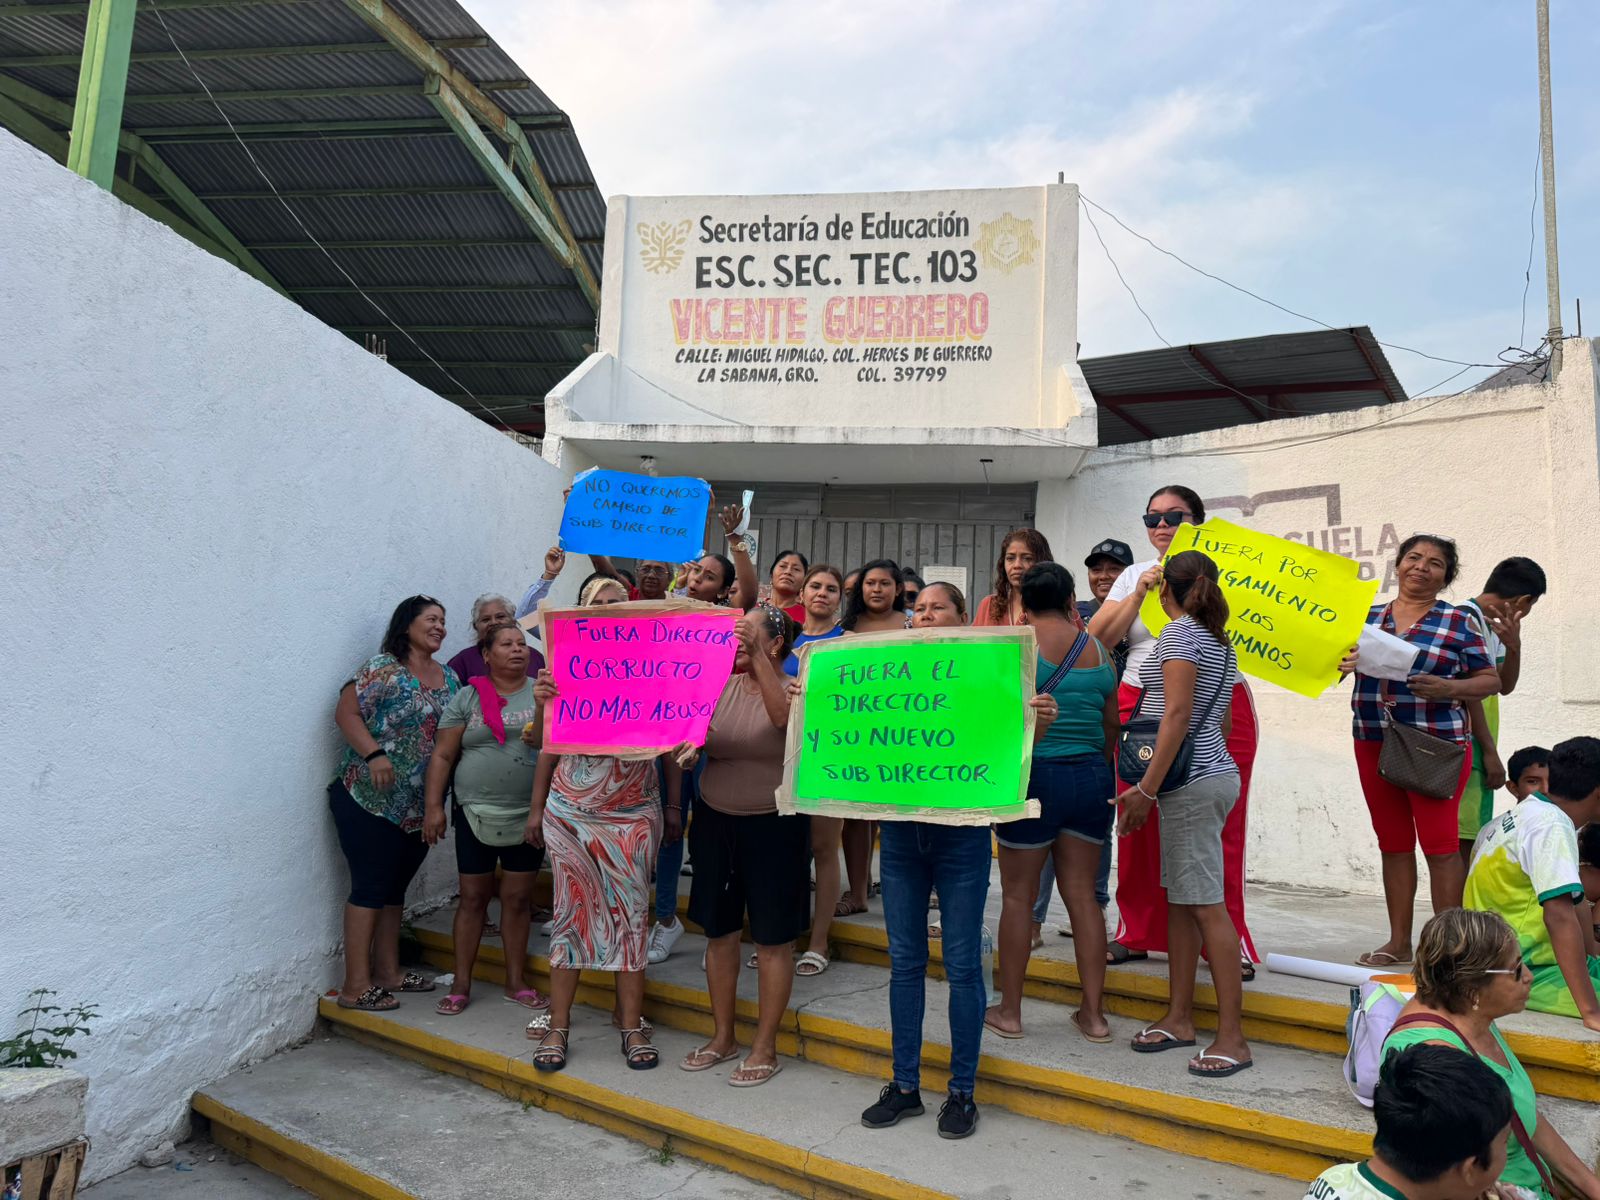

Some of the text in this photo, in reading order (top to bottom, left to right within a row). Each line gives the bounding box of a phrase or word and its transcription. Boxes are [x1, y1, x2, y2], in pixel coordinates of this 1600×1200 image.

[699, 210, 969, 244] Secretaría de Educación
[696, 249, 978, 289] ESC. SEC. TEC. 103
[670, 292, 990, 345] VICENTE GUERRERO
[675, 345, 993, 365] CALLE: MIGUEL HIDALGO, COL. HEROES DE GUERRERO
[697, 365, 948, 385] LA SABANA, GRO. COL. 39799
[585, 478, 701, 499] NO QUEREMOS
[593, 498, 681, 516] CAMBIO DE
[568, 516, 688, 538] SUB DIRECTOR
[1191, 527, 1264, 566] FUERA
[1279, 555, 1318, 584] POR
[1237, 607, 1274, 632] LOS
[650, 619, 734, 649] DIRECTOR
[569, 655, 702, 681] CORRUCTO
[833, 659, 960, 686] FUERA EL
[558, 696, 594, 725] NO
[599, 695, 643, 724] MAS
[827, 692, 952, 714] DIRECTOR
[830, 729, 860, 746] SU
[869, 726, 956, 748] NUEVO
[822, 764, 871, 783] SUB
